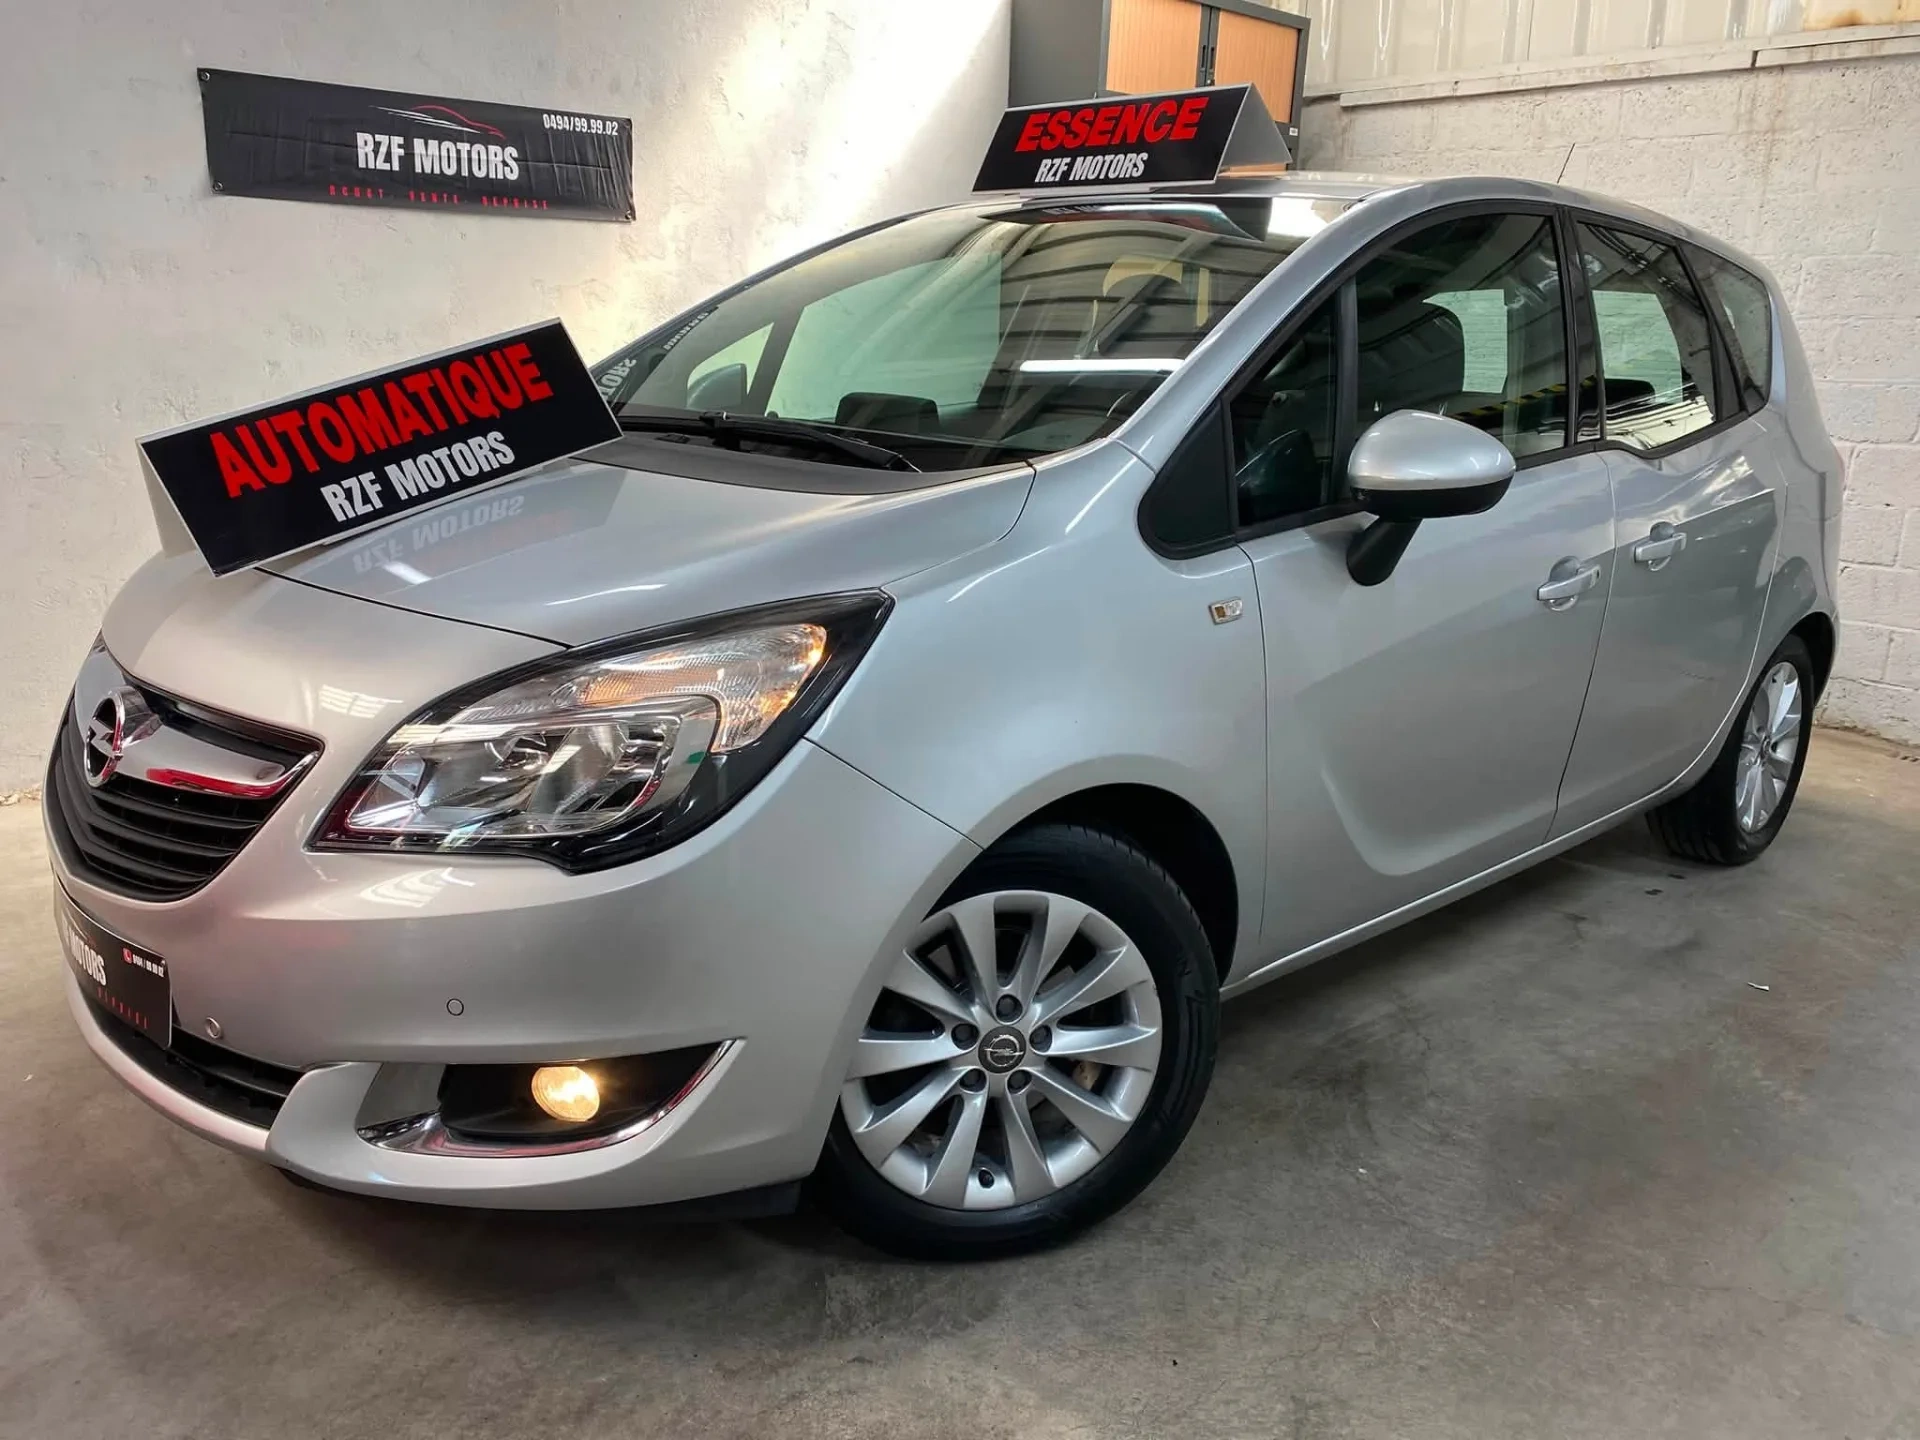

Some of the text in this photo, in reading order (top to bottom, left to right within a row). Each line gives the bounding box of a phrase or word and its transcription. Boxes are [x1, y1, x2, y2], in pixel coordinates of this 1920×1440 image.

[542, 113, 618, 136] 0494/99.99.02
[1015, 96, 1209, 152] ESSENCE
[356, 132, 519, 181] RZF MOTORS
[1034, 152, 1149, 183] RZF MOTORS
[210, 342, 553, 498] AUTOMATIQUE
[320, 431, 515, 522] RZF MOTORS
